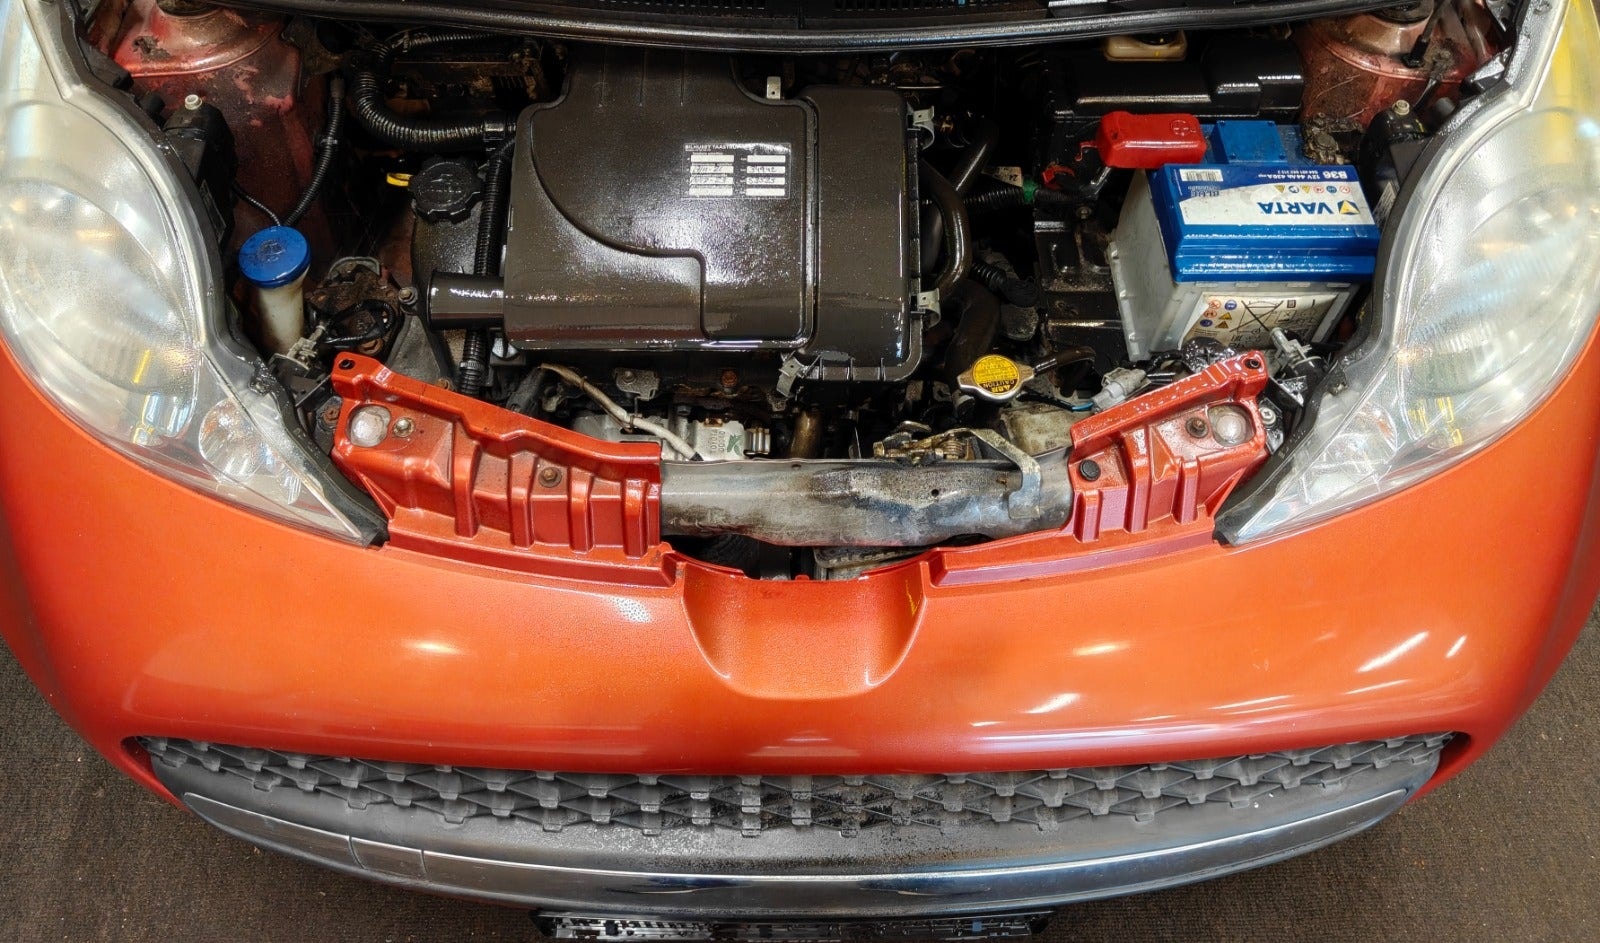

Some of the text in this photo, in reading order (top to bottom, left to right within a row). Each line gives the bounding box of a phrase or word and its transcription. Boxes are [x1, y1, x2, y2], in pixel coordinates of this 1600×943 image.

[1322, 171, 1347, 179] B36
[1257, 202, 1334, 215] VARTA
[983, 380, 1014, 388] CAUTION
